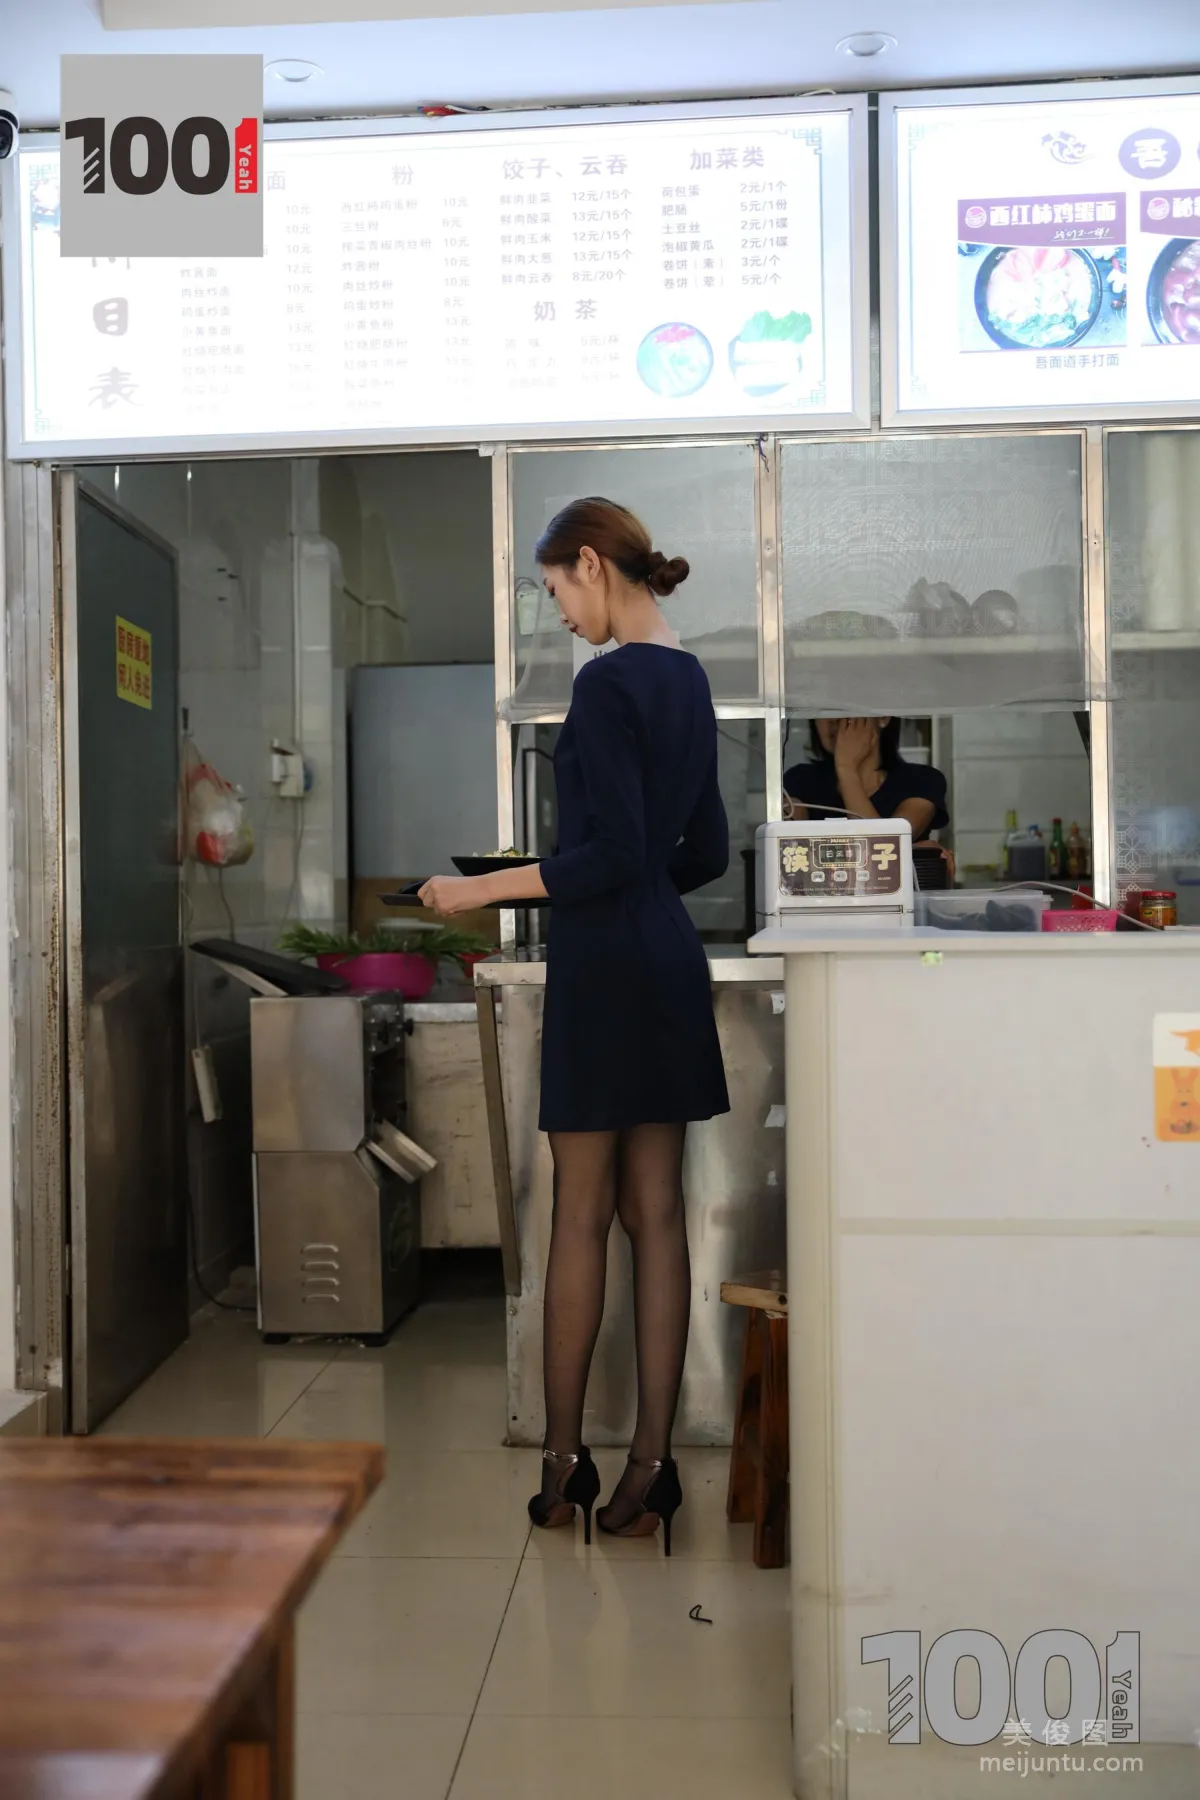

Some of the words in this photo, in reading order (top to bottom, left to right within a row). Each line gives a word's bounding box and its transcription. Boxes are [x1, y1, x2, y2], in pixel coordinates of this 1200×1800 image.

[690, 146, 764, 170] 加菜类
[392, 164, 414, 185] 粉
[500, 192, 551, 205] 鲜肉韭菜
[572, 188, 632, 202] 12元/15个
[661, 184, 700, 199] 荷包蛋
[740, 180, 787, 194] 2元/1个
[444, 196, 468, 207] 10元
[662, 203, 687, 217] 肥肠
[740, 199, 787, 212] 5元/1份
[500, 212, 551, 226] 鲜肉酸菜
[573, 208, 632, 222] 13元/15个
[989, 200, 1117, 227] 西红柿鸡蛋面
[662, 221, 701, 234] 土豆丝
[741, 217, 788, 230] 2元/1碟
[444, 236, 470, 248] 10元
[500, 232, 551, 245] 鲜肉玉米
[573, 228, 632, 242] 12元/15个
[661, 239, 714, 253] 泡椒黄瓜
[741, 236, 788, 249] 2元/1碟
[444, 256, 470, 267] 10元
[501, 252, 553, 265] 鲜肉大葱
[573, 249, 632, 262] 13元/15个
[742, 254, 780, 267] 3元/个
[444, 276, 470, 287] 10元
[502, 272, 553, 285] 鲜肉云吞
[572, 269, 626, 282] 8元/20个
[742, 272, 781, 285] 5元/个
[1036, 354, 1120, 370] 吾面道手打面
[782, 845, 810, 874] 筷
[871, 843, 898, 871] 子
